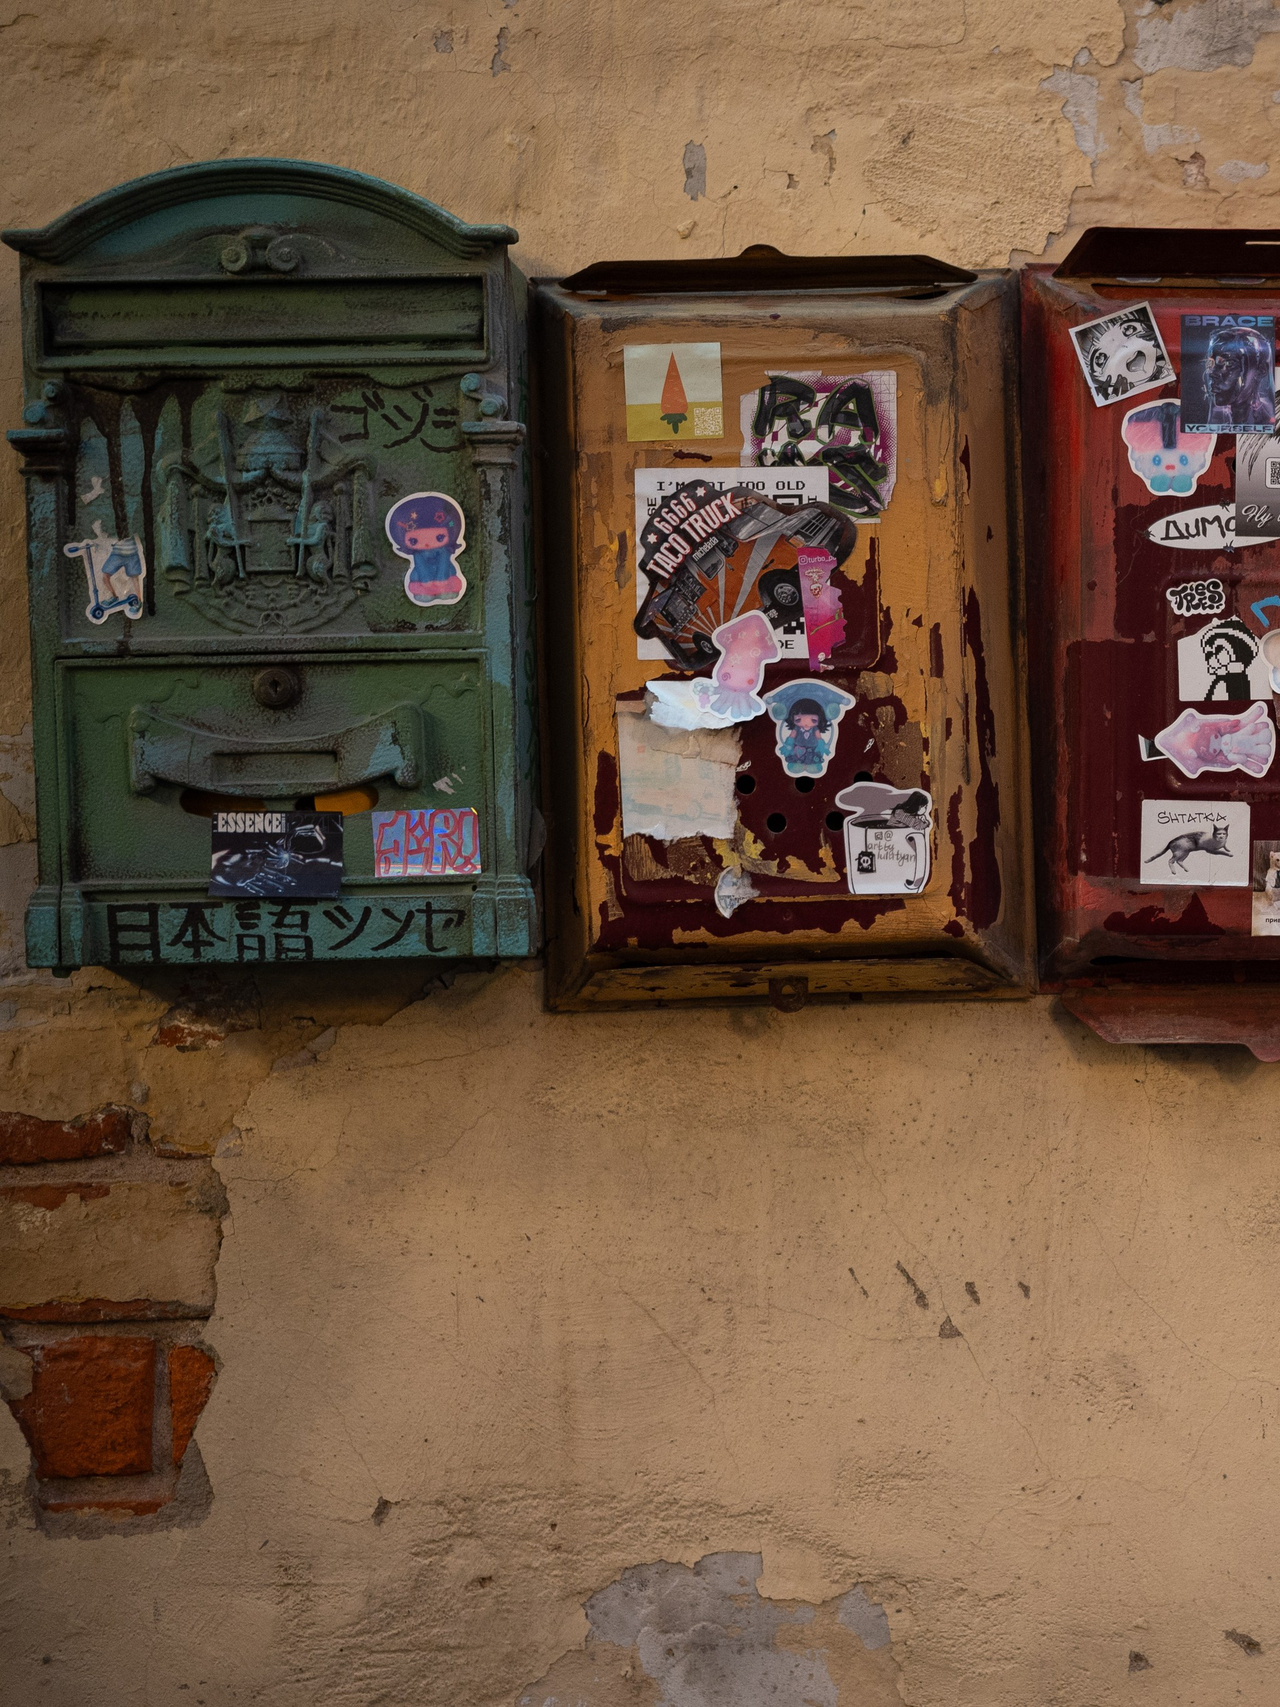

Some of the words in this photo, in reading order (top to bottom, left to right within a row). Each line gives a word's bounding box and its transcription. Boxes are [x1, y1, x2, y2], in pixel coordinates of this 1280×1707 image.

[1185, 316, 1274, 327] BRACE
[1186, 424, 1272, 432] YOURSELF
[737, 481, 766, 491] TOO
[775, 480, 806, 490] OLD
[653, 492, 698, 535] 6666
[1242, 504, 1273, 528] Fly
[646, 532, 692, 579] TACO
[680, 492, 743, 543] TRUCK
[217, 812, 282, 833] ESSENCE
[1157, 810, 1227, 825] SHTATKA
